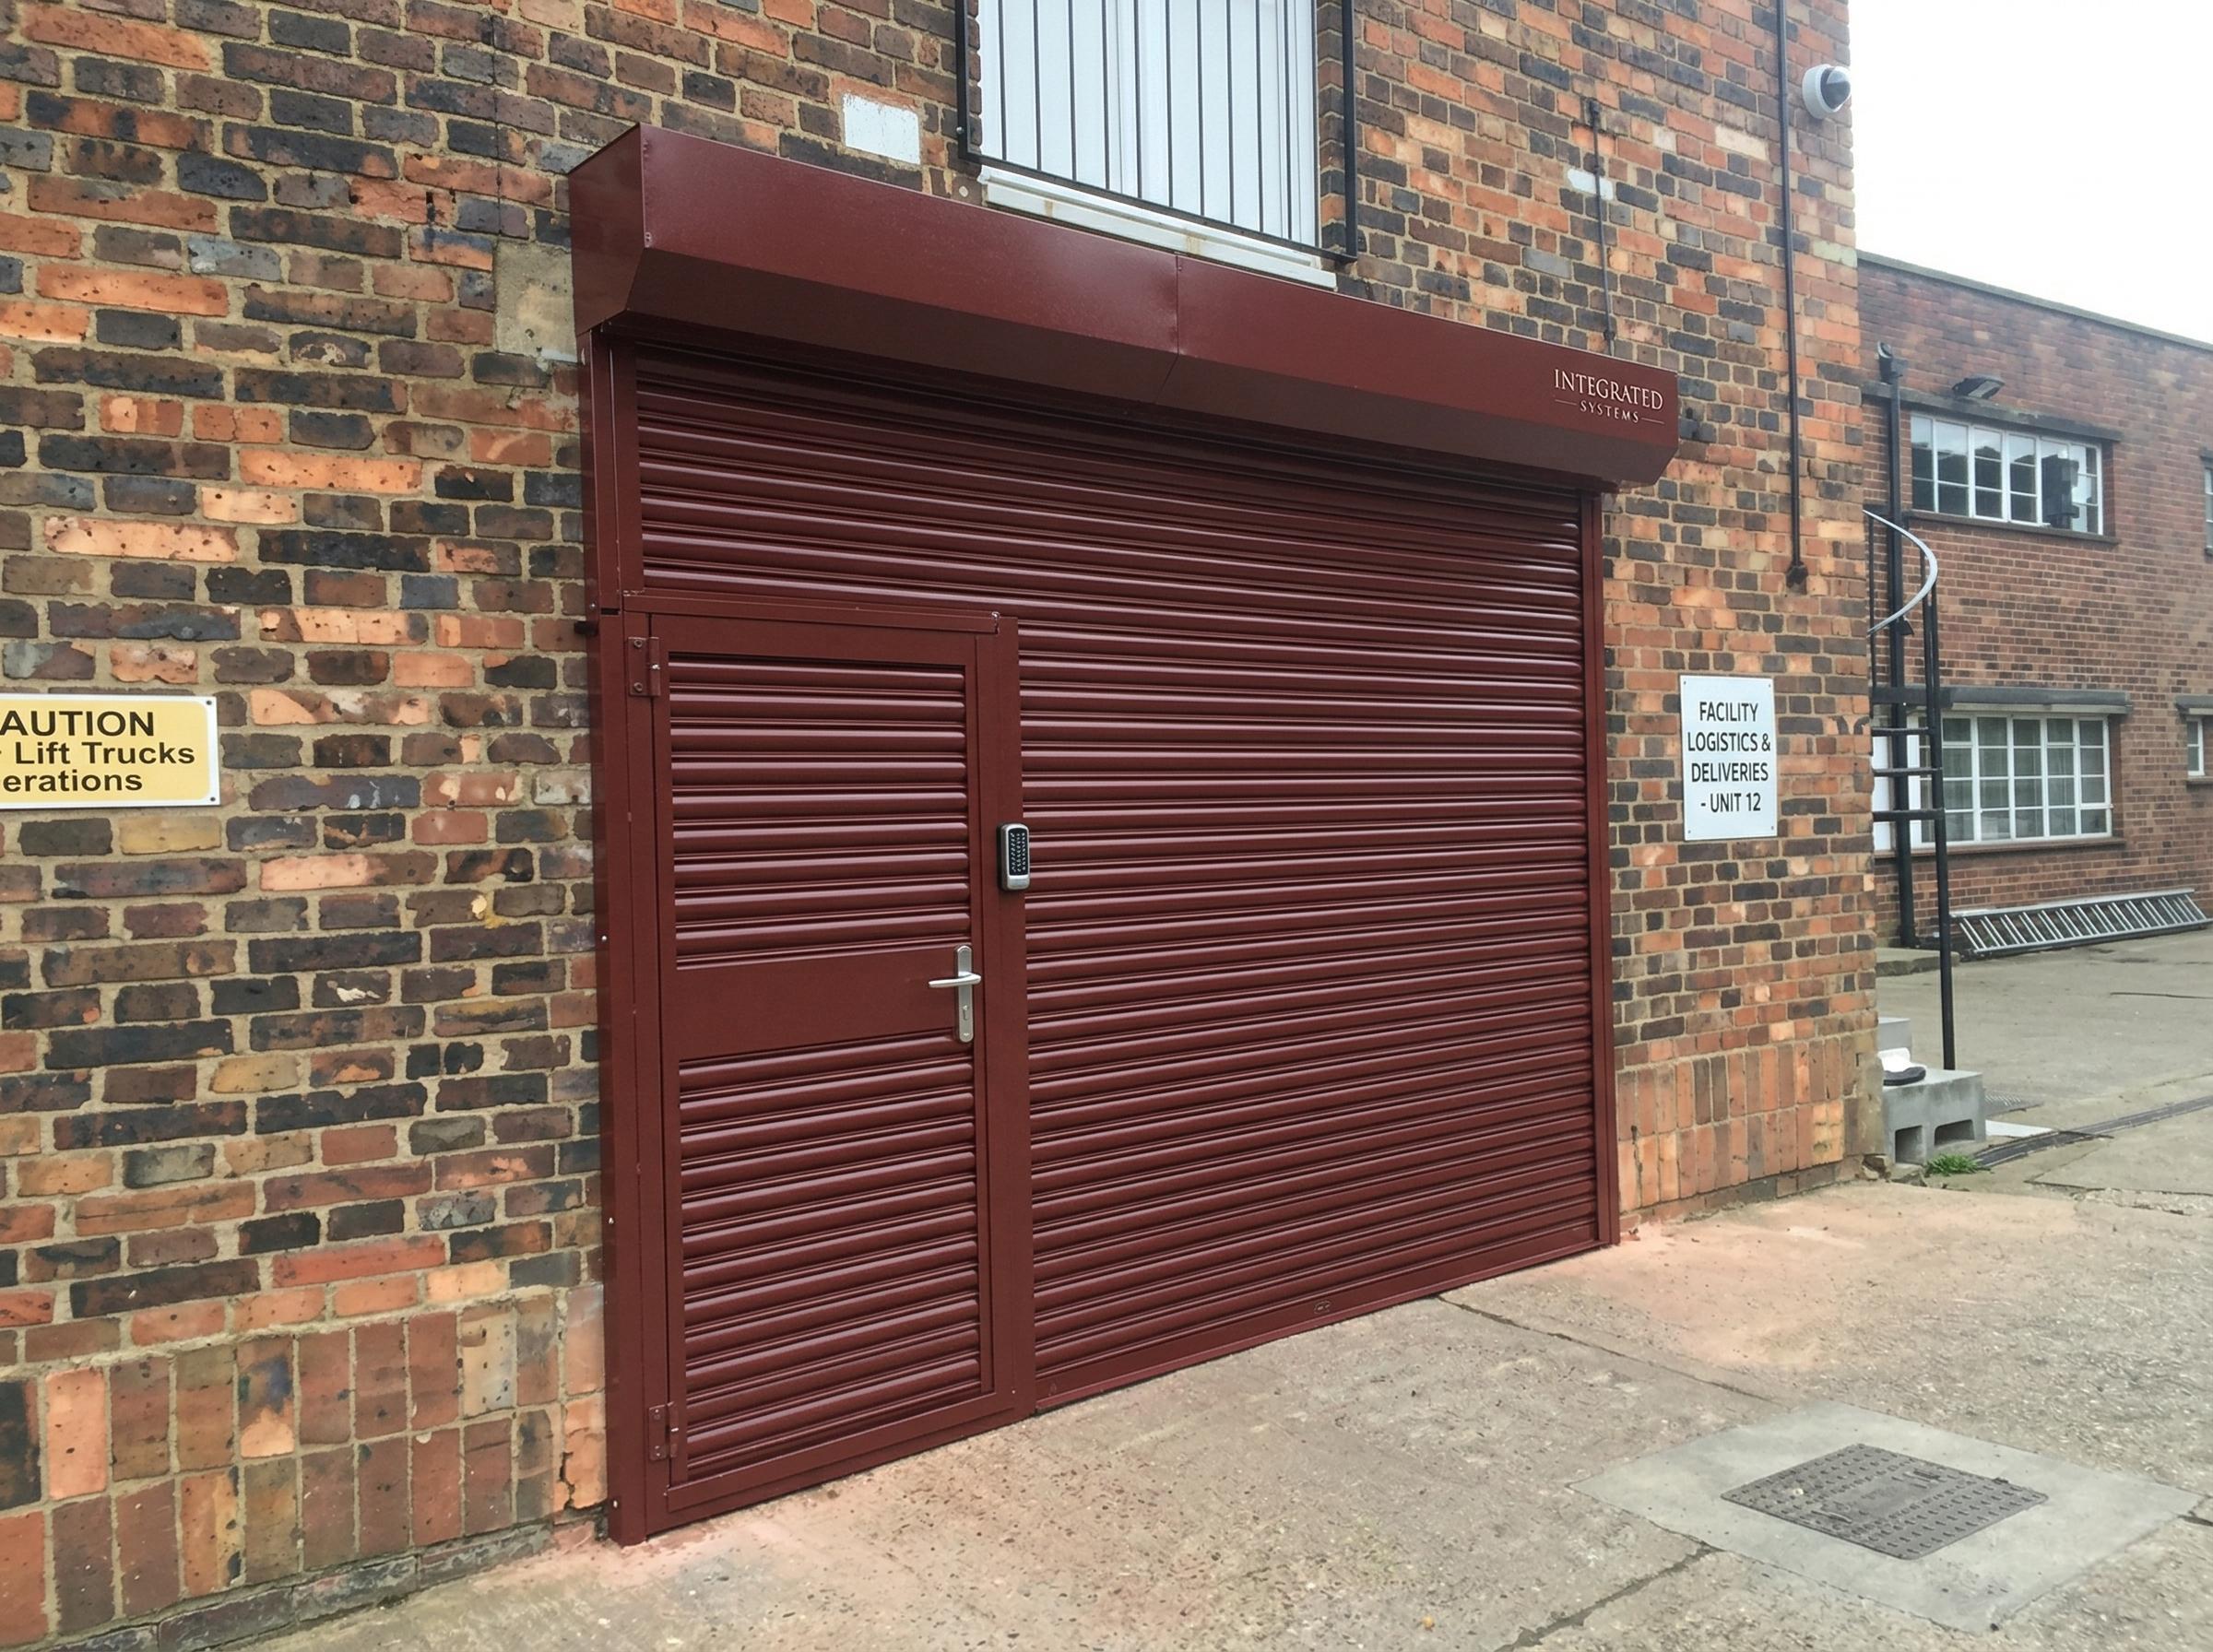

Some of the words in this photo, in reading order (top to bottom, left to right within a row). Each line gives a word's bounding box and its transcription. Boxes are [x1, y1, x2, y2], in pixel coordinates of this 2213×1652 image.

[1555, 369, 1663, 410] INTEGRATED
[1580, 399, 1639, 423] SYSTEMS
[1699, 702, 1758, 722] FACILITY
[1687, 732, 1757, 751] LOGISTICS
[1761, 733, 1770, 751] &
[15, 741, 70, 764] Lift
[81, 741, 195, 764] Trucks
[1691, 762, 1769, 783] DELIVERIES
[1710, 793, 1742, 813] UNIT
[1746, 792, 1761, 811] 12
